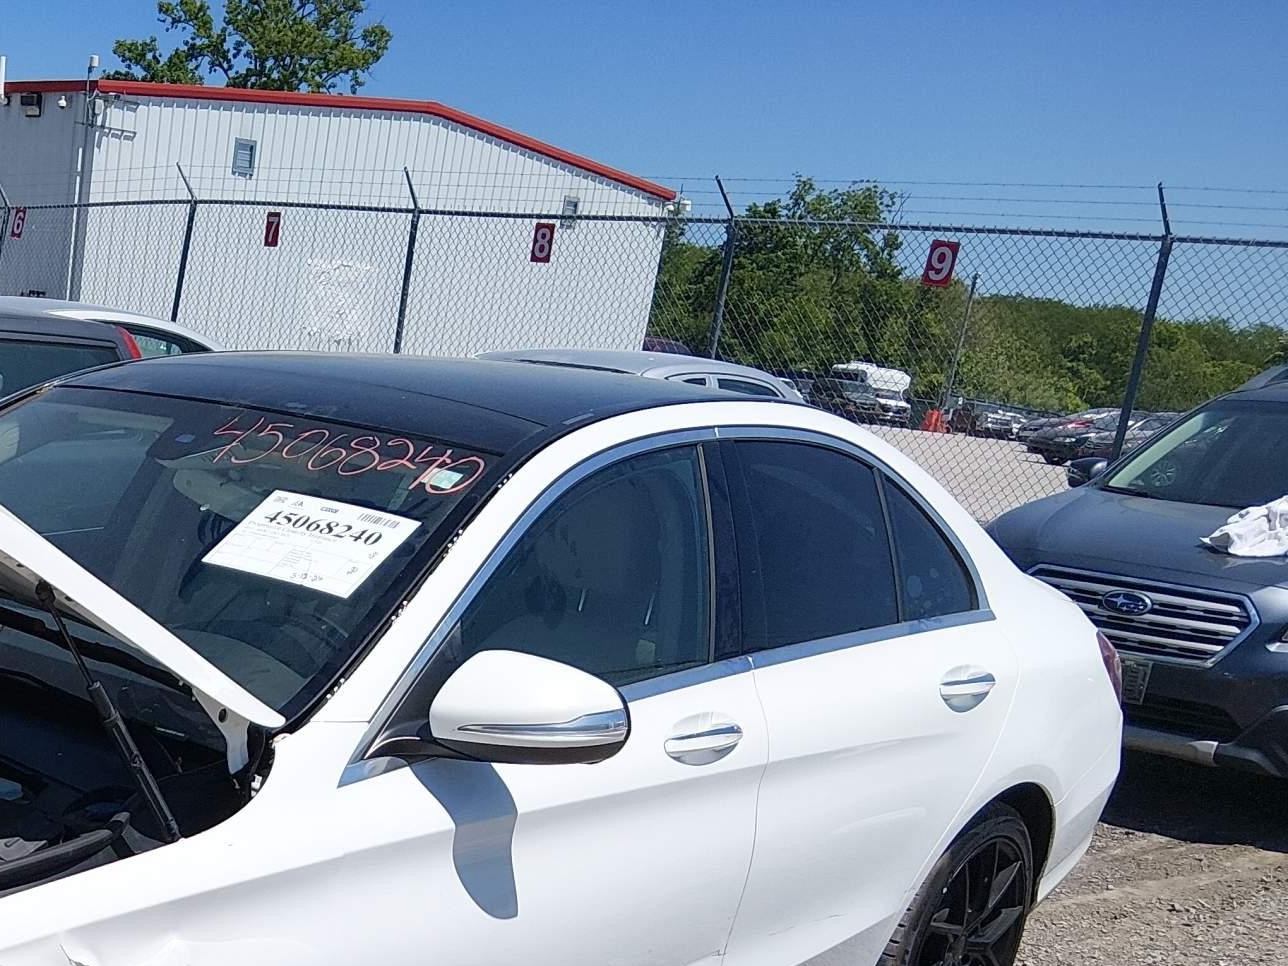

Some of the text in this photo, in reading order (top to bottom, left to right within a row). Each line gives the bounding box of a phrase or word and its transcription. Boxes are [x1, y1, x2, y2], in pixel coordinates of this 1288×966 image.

[13, 212, 24, 234] 6
[268, 216, 279, 242] 7
[534, 227, 551, 258] 8
[928, 246, 953, 281] 9
[213, 416, 485, 494] 45068240
[264, 510, 383, 547] 45068240
